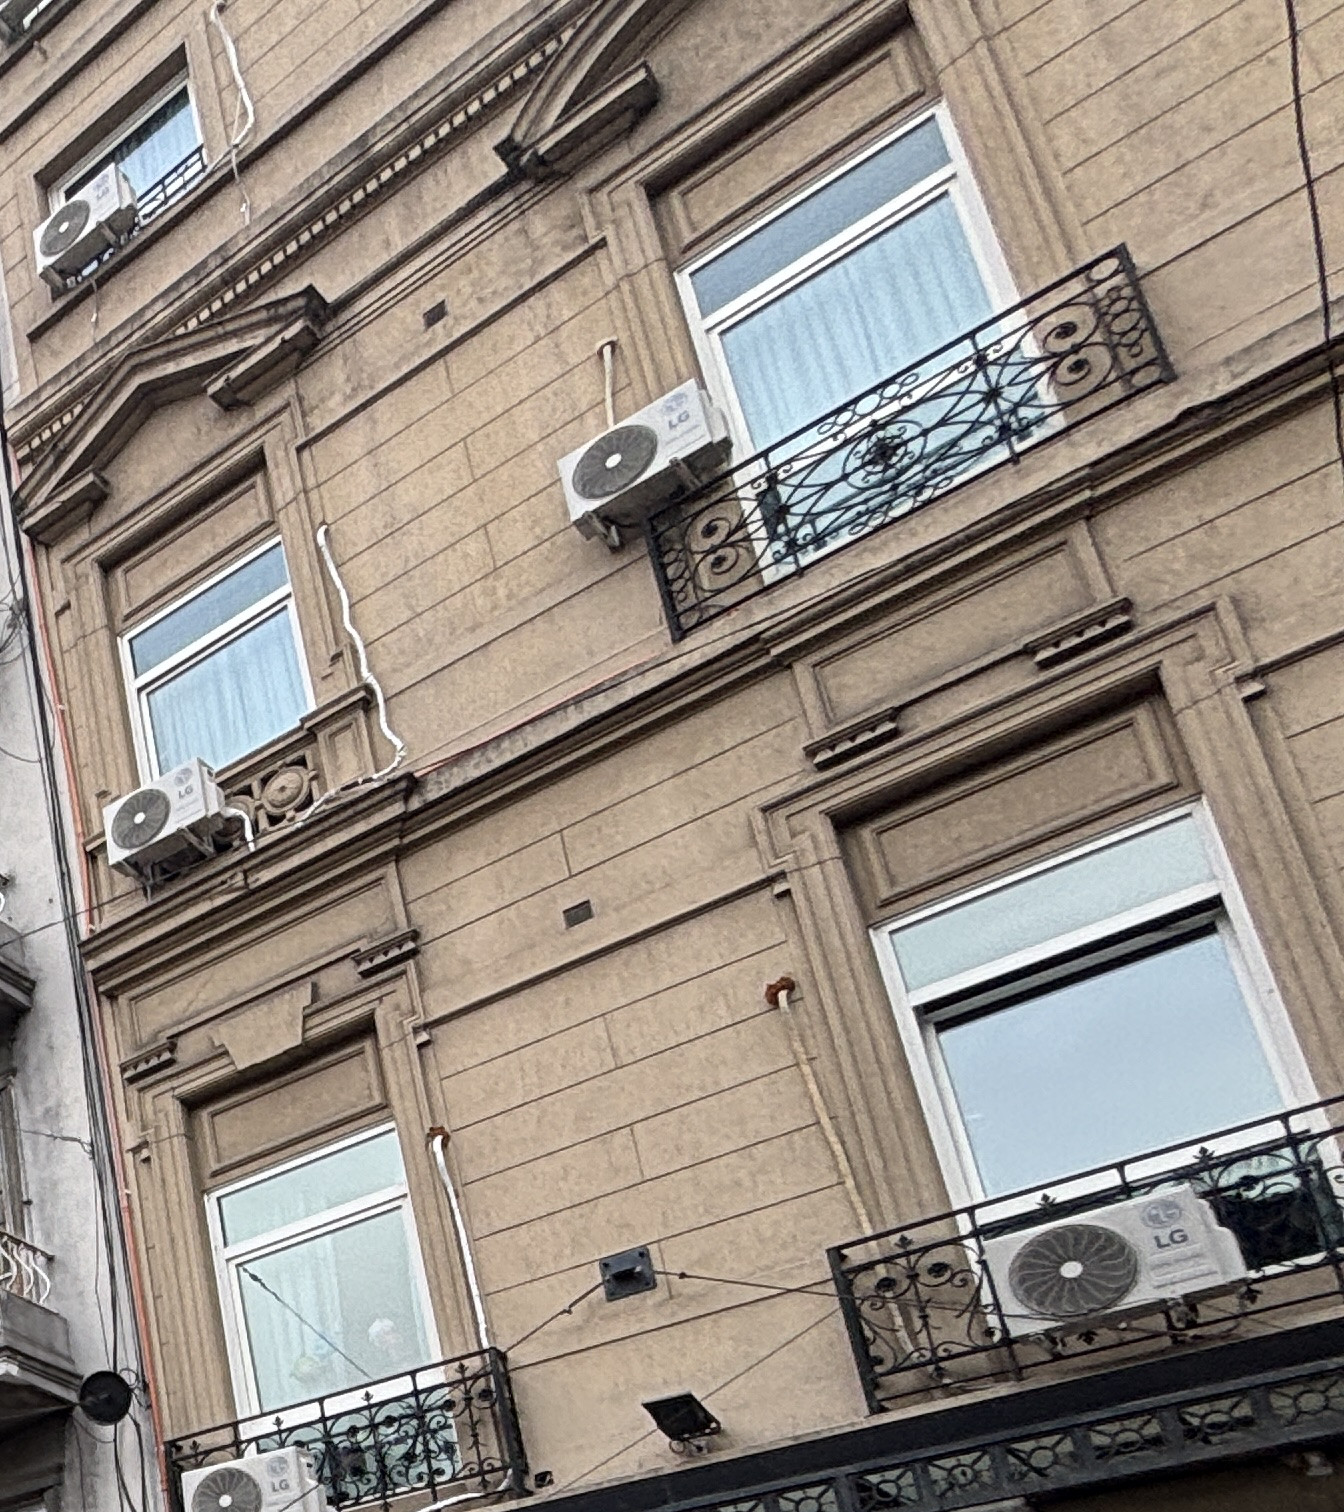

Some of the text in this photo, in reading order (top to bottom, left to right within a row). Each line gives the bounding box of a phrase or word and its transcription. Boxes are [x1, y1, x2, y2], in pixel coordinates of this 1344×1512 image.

[668, 410, 690, 431] LG
[178, 784, 194, 800] LG
[1153, 1228, 1189, 1249] LG
[271, 1478, 290, 1493] LG
